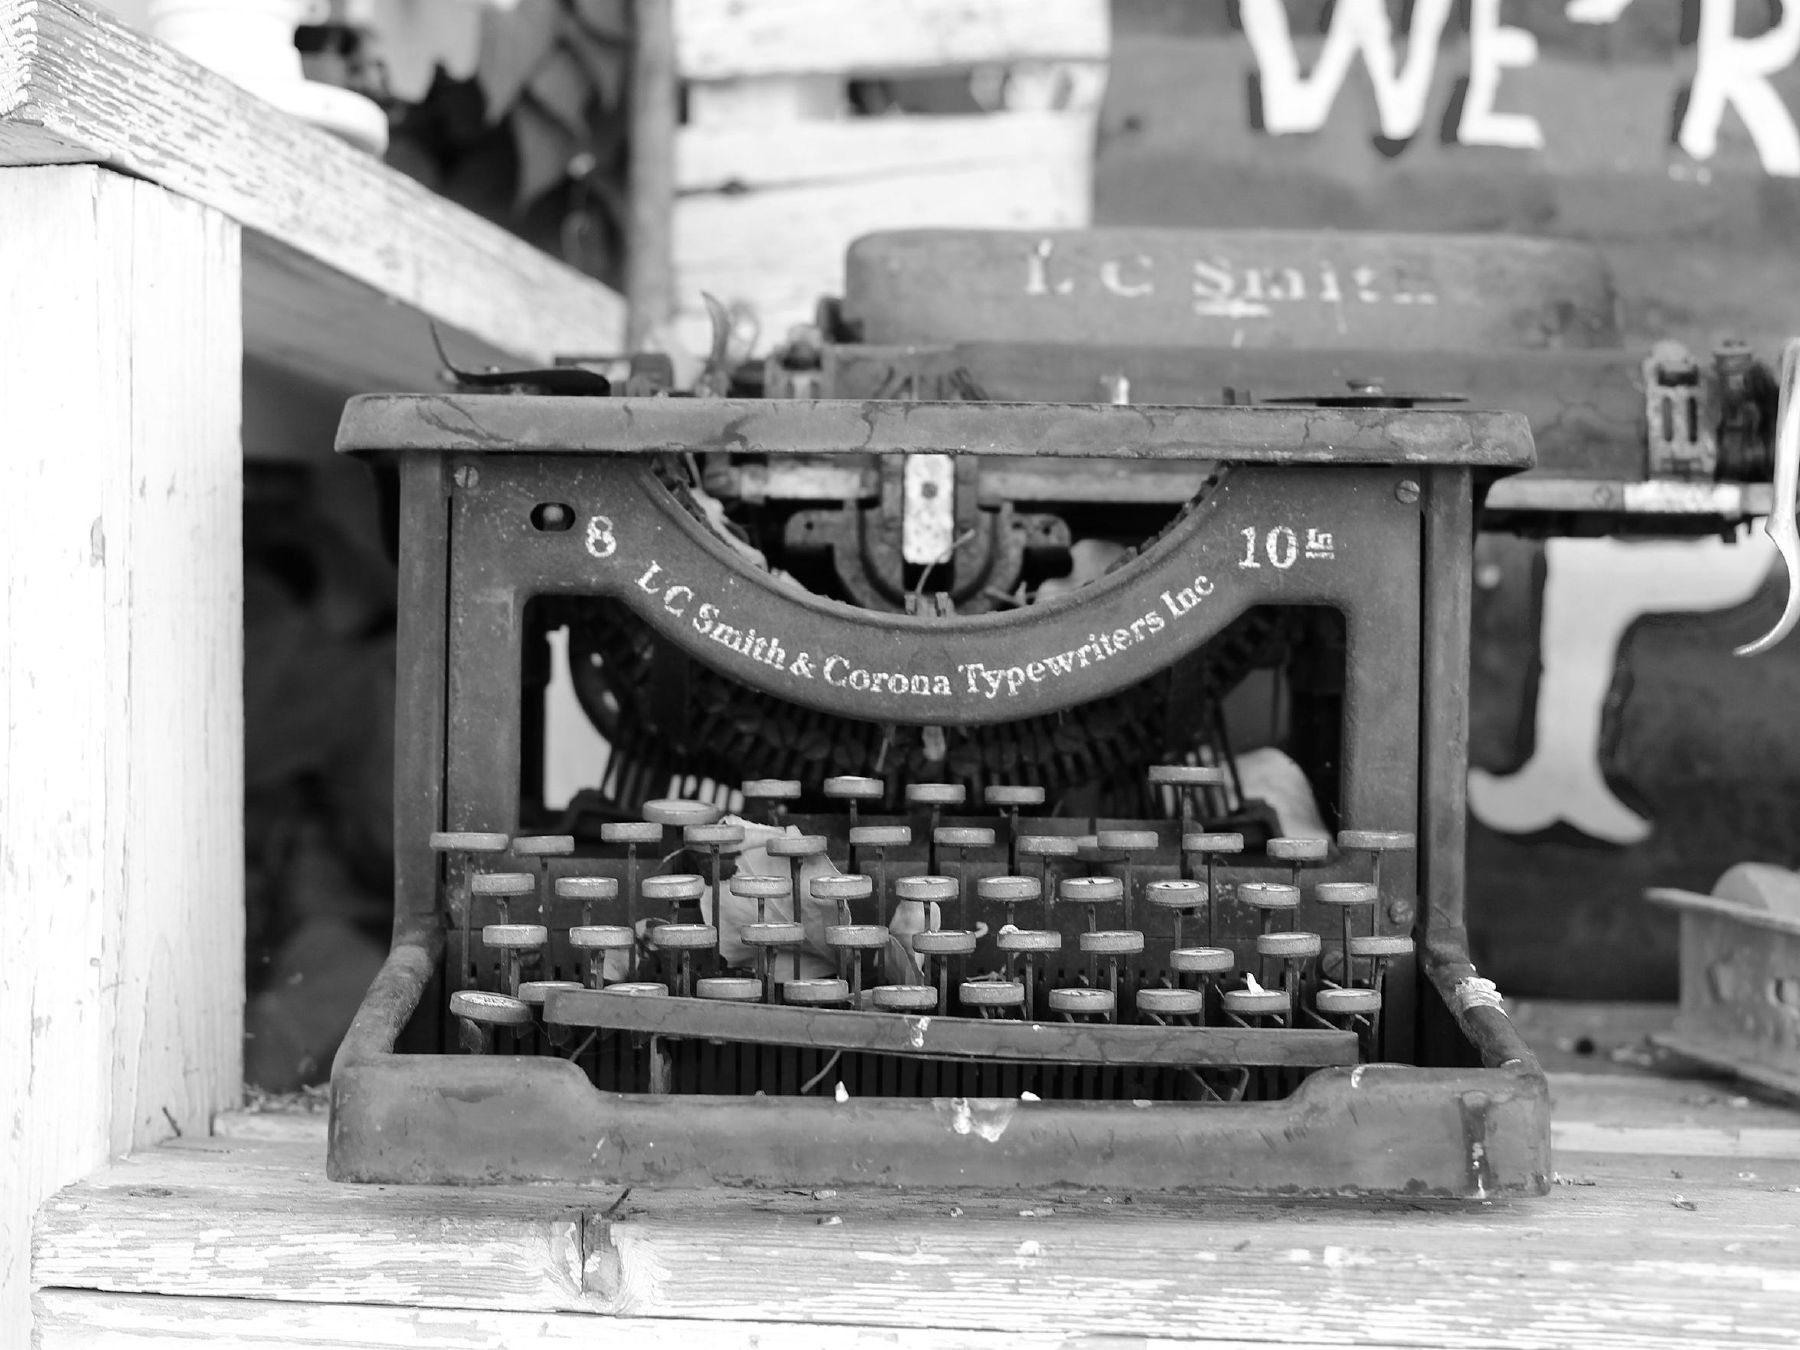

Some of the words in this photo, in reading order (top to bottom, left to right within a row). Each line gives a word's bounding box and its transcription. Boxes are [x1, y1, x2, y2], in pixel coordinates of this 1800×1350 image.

[1101, 256, 1152, 297] C
[585, 515, 617, 558] 8
[1238, 525, 1297, 570] 10
[635, 559, 663, 595] L
[663, 585, 695, 618] C
[692, 602, 786, 671] Smith
[789, 652, 816, 680] &
[823, 654, 952, 697] Corona
[958, 608, 1166, 700] Typewriters
[1160, 575, 1215, 618] Inc
